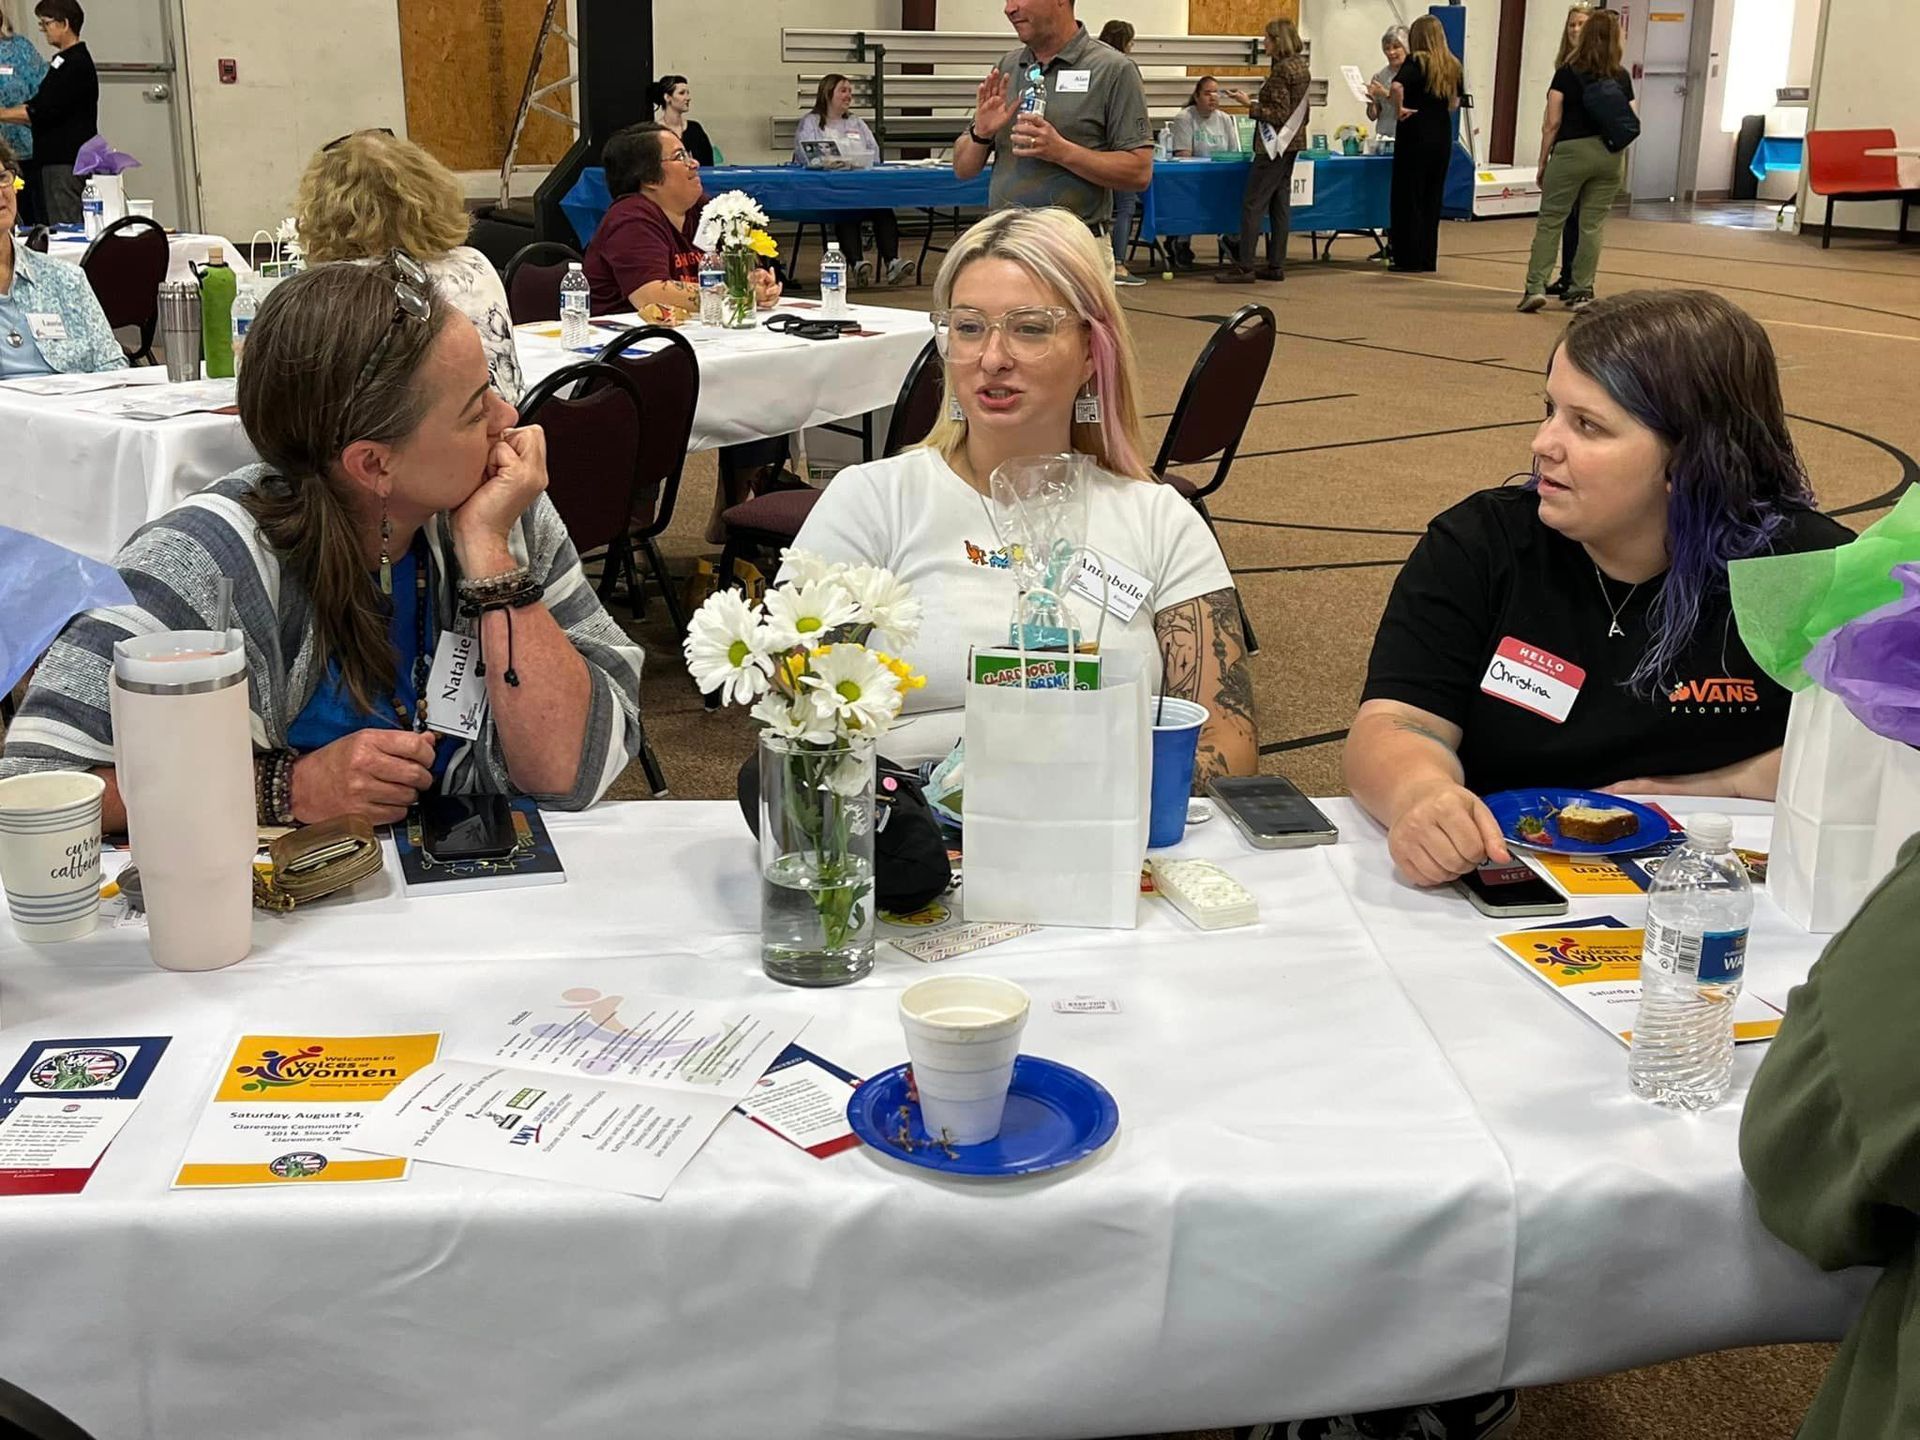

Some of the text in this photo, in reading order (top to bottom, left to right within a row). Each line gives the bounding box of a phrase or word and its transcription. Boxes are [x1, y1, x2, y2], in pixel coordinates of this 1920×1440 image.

[1293, 179, 1307, 194] RT
[1520, 648, 1564, 672] HELLO
[442, 639, 471, 702] Natalie
[1490, 660, 1551, 699] Christina
[1689, 679, 1758, 702] VANS
[1671, 705, 1760, 713] FLORIDA
[1571, 954, 1642, 963] Wome
[294, 1061, 356, 1069] Voices
[286, 1067, 397, 1078] Women
[230, 1112, 291, 1120] Saturday,
[295, 1112, 340, 1120] August
